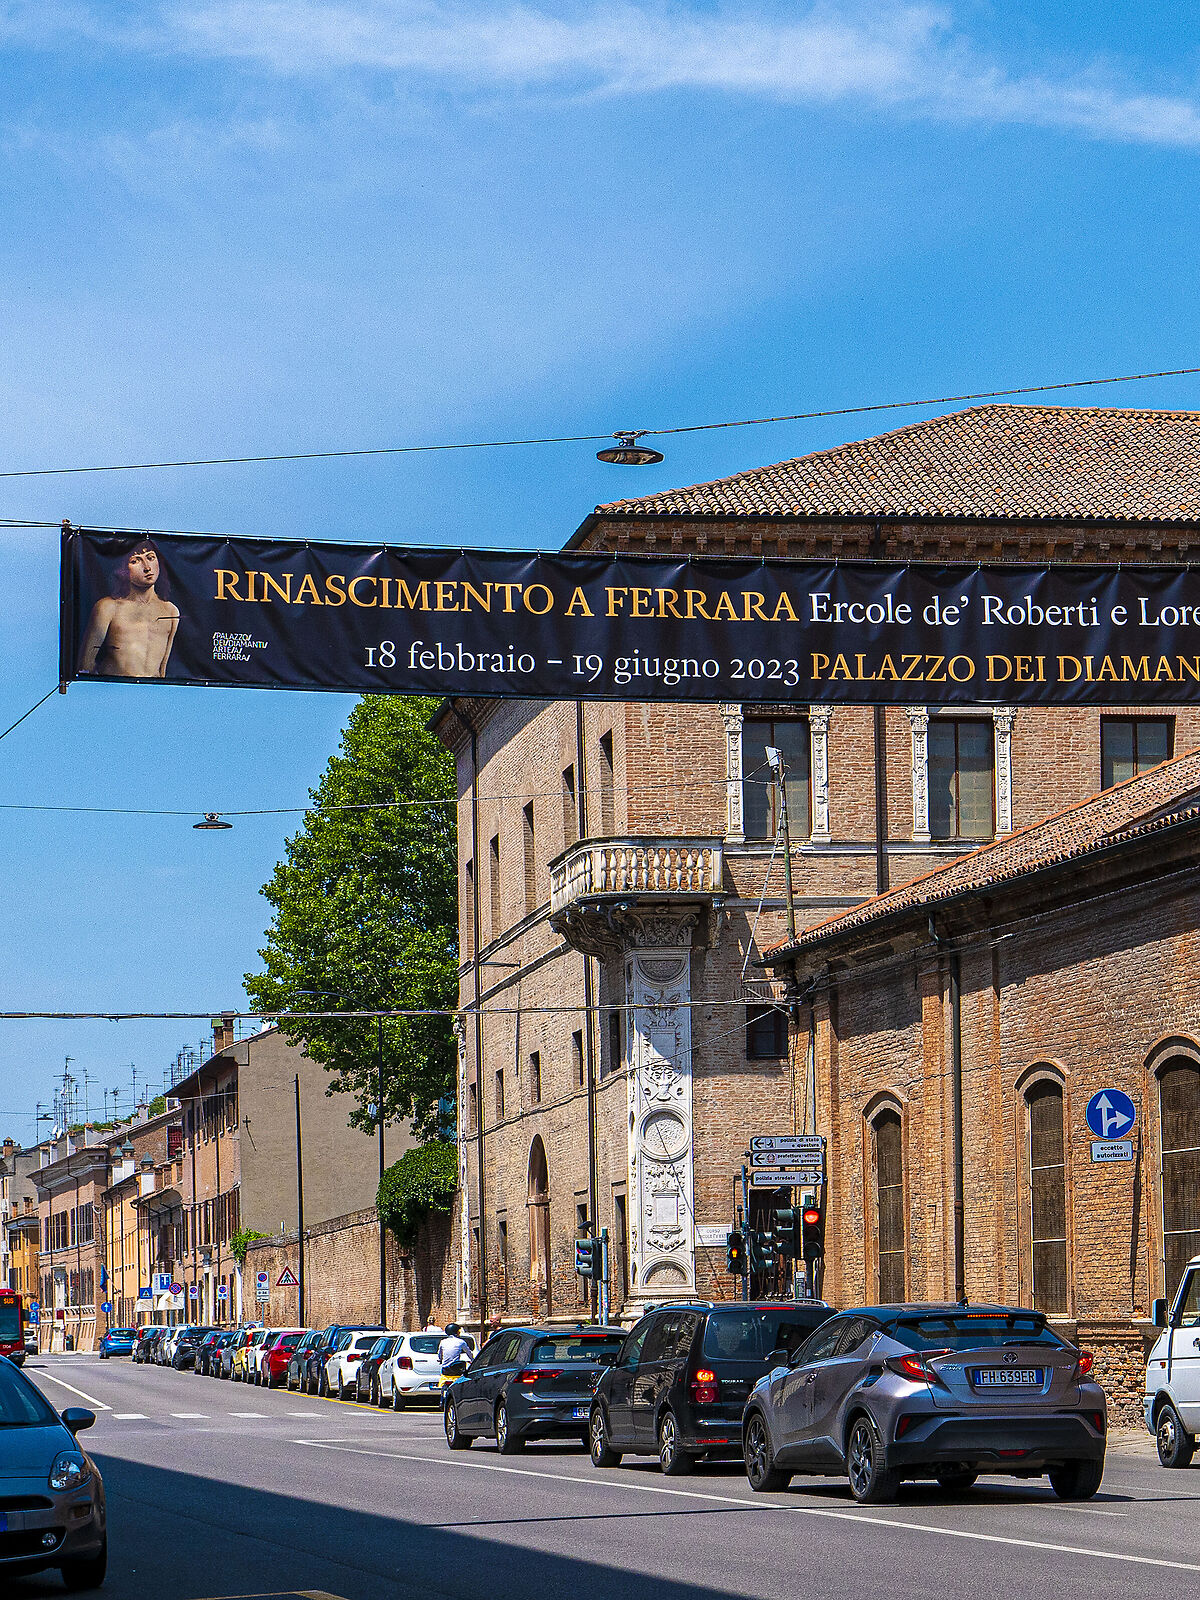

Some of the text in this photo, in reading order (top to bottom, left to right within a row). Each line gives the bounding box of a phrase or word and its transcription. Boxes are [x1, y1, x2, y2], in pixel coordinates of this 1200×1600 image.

[213, 567, 555, 616] RINASCIMENTO
[564, 585, 595, 617] A
[604, 584, 800, 621] FERRARA
[809, 591, 912, 628] Ercole
[980, 595, 1101, 626] Roberti
[1110, 605, 1128, 626] e
[364, 641, 397, 668] 18
[407, 641, 536, 672] febbraio
[572, 655, 604, 682] 19
[613, 649, 720, 685] giugno
[730, 659, 800, 686] 2023
[810, 653, 975, 682] PALAZZO
[985, 655, 1047, 681] DEI
